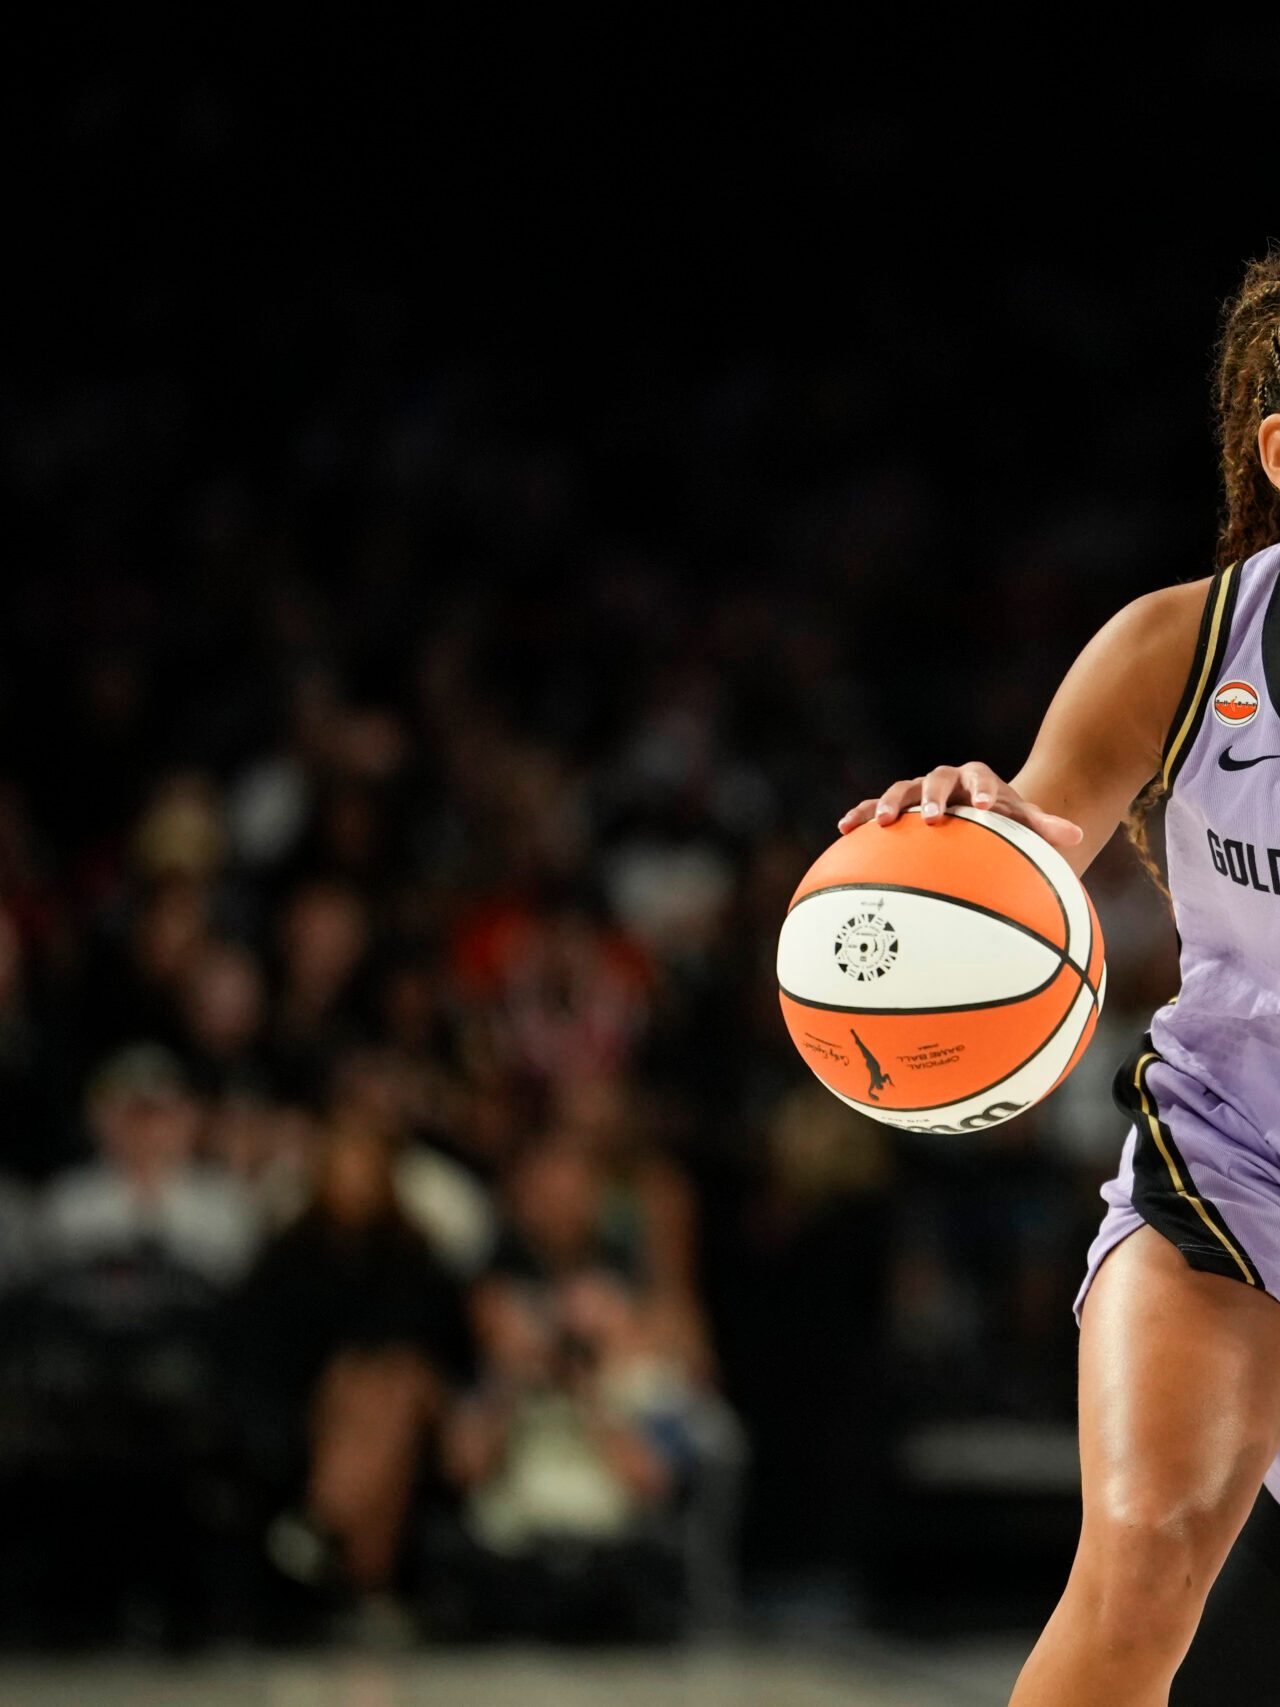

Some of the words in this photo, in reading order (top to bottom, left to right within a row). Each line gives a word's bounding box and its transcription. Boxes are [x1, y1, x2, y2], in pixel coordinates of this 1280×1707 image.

[896, 1053, 928, 1062] BALL
[929, 1044, 965, 1058] GAME
[906, 1055, 960, 1070] OFFICIAL
